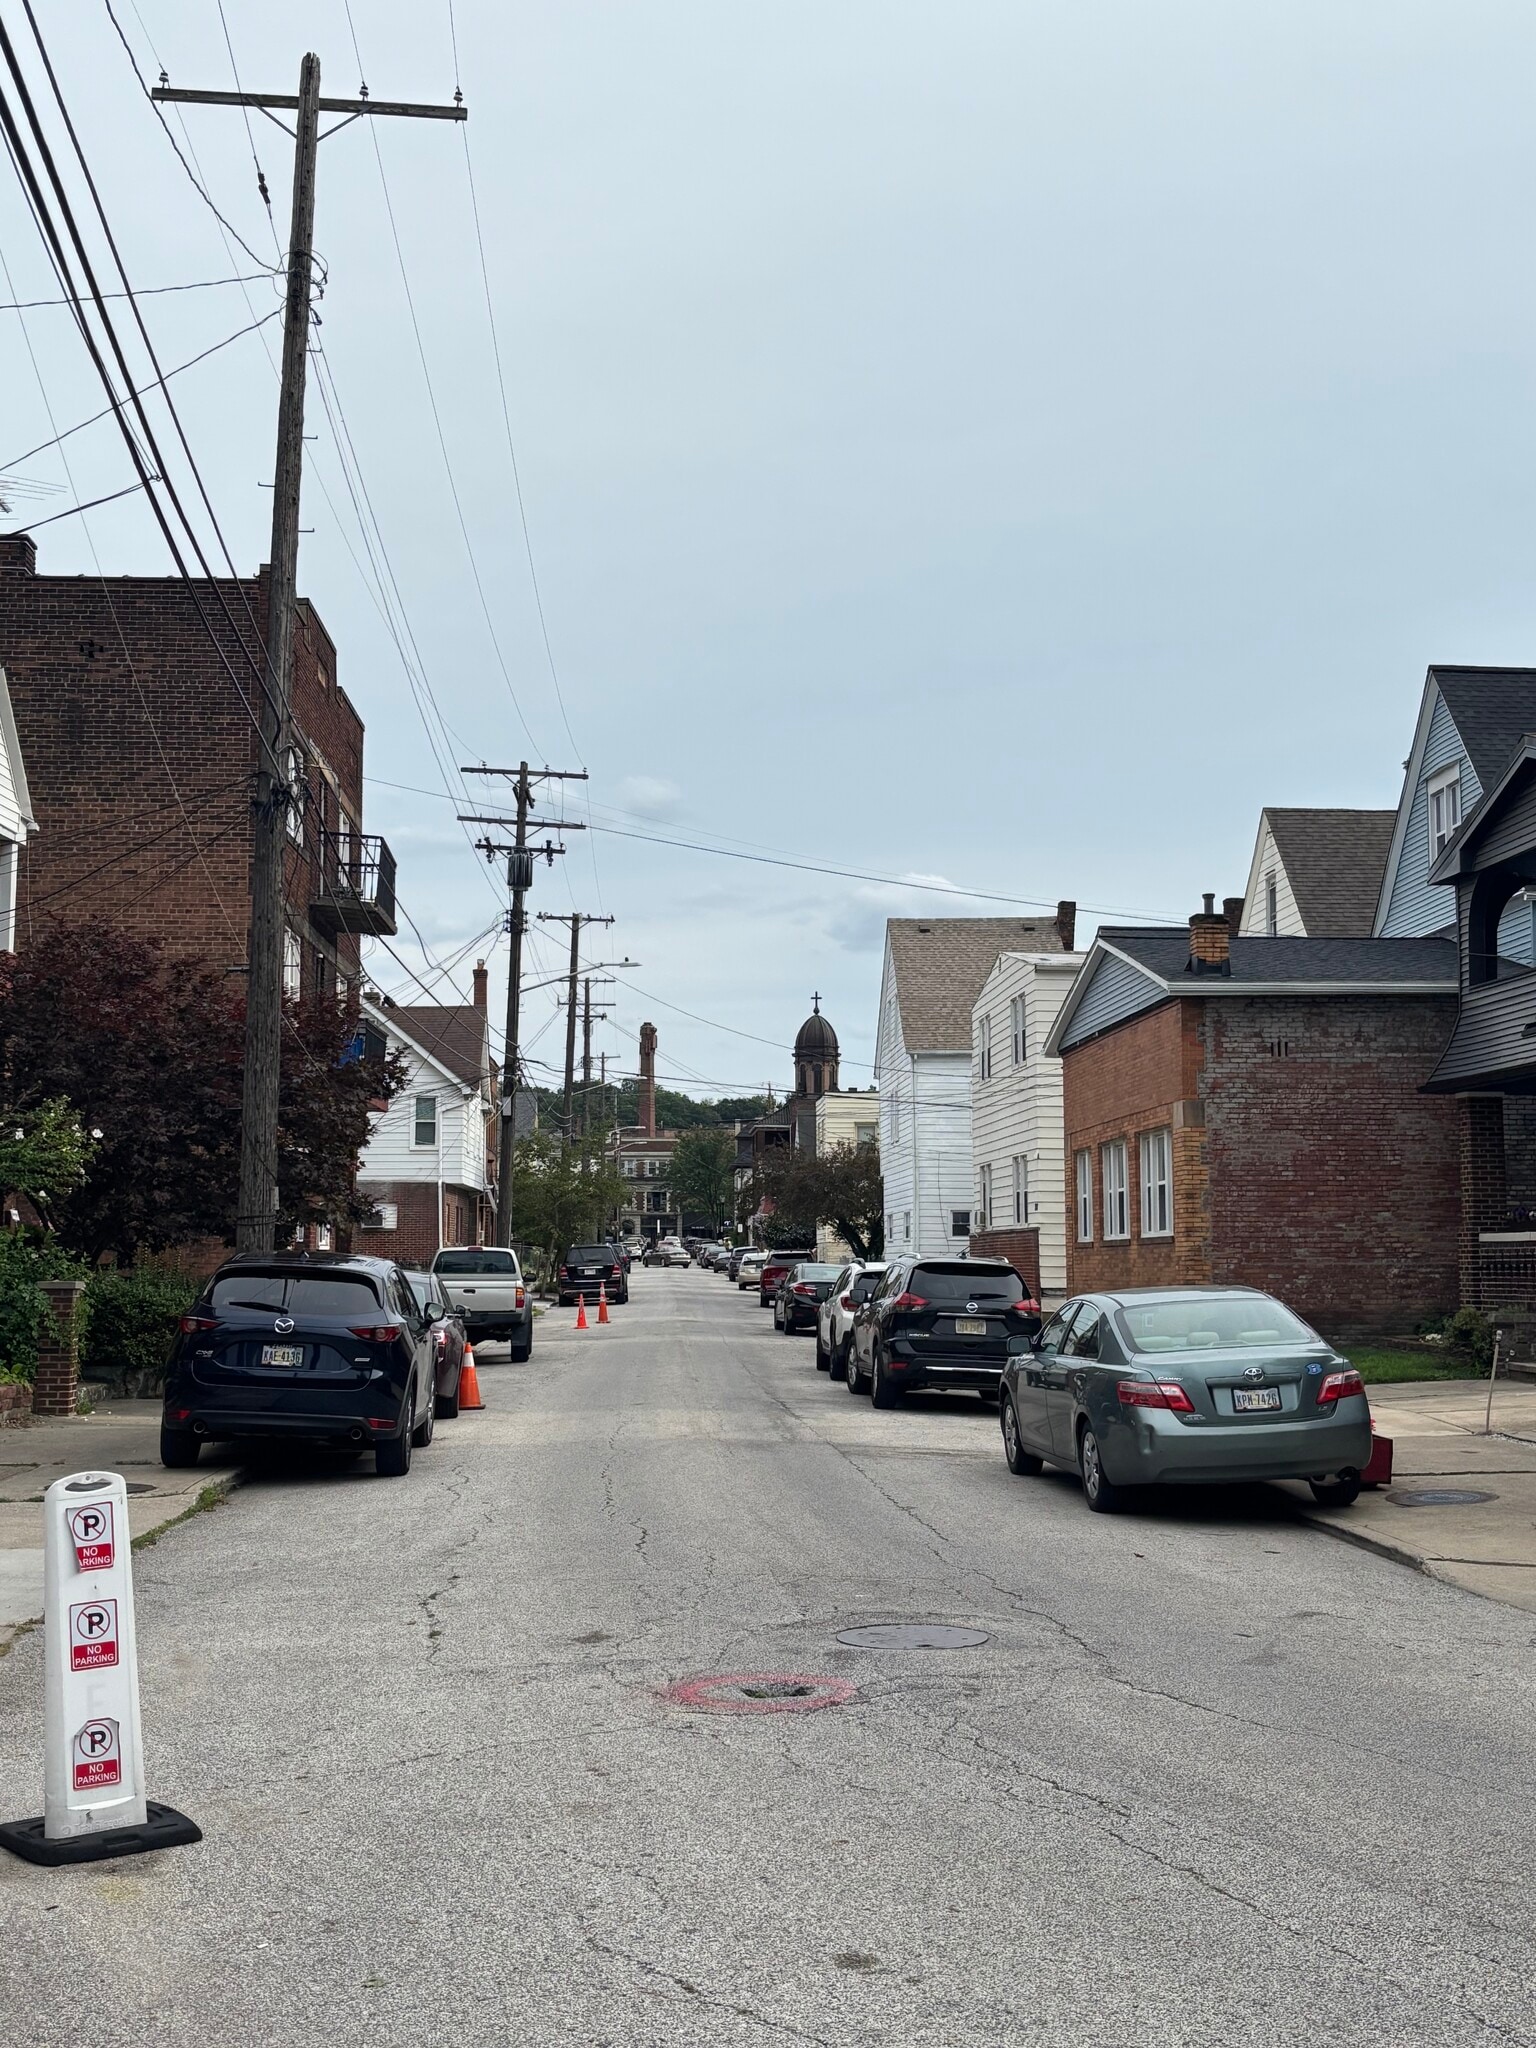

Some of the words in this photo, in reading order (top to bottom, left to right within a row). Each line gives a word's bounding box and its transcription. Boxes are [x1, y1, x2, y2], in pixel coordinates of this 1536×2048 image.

[83, 1547, 98, 1557] NO
[87, 1645, 102, 1655] NO
[75, 1653, 115, 1666] PARKING
[89, 1763, 104, 1774] NO
[77, 1771, 117, 1785] PARKING
